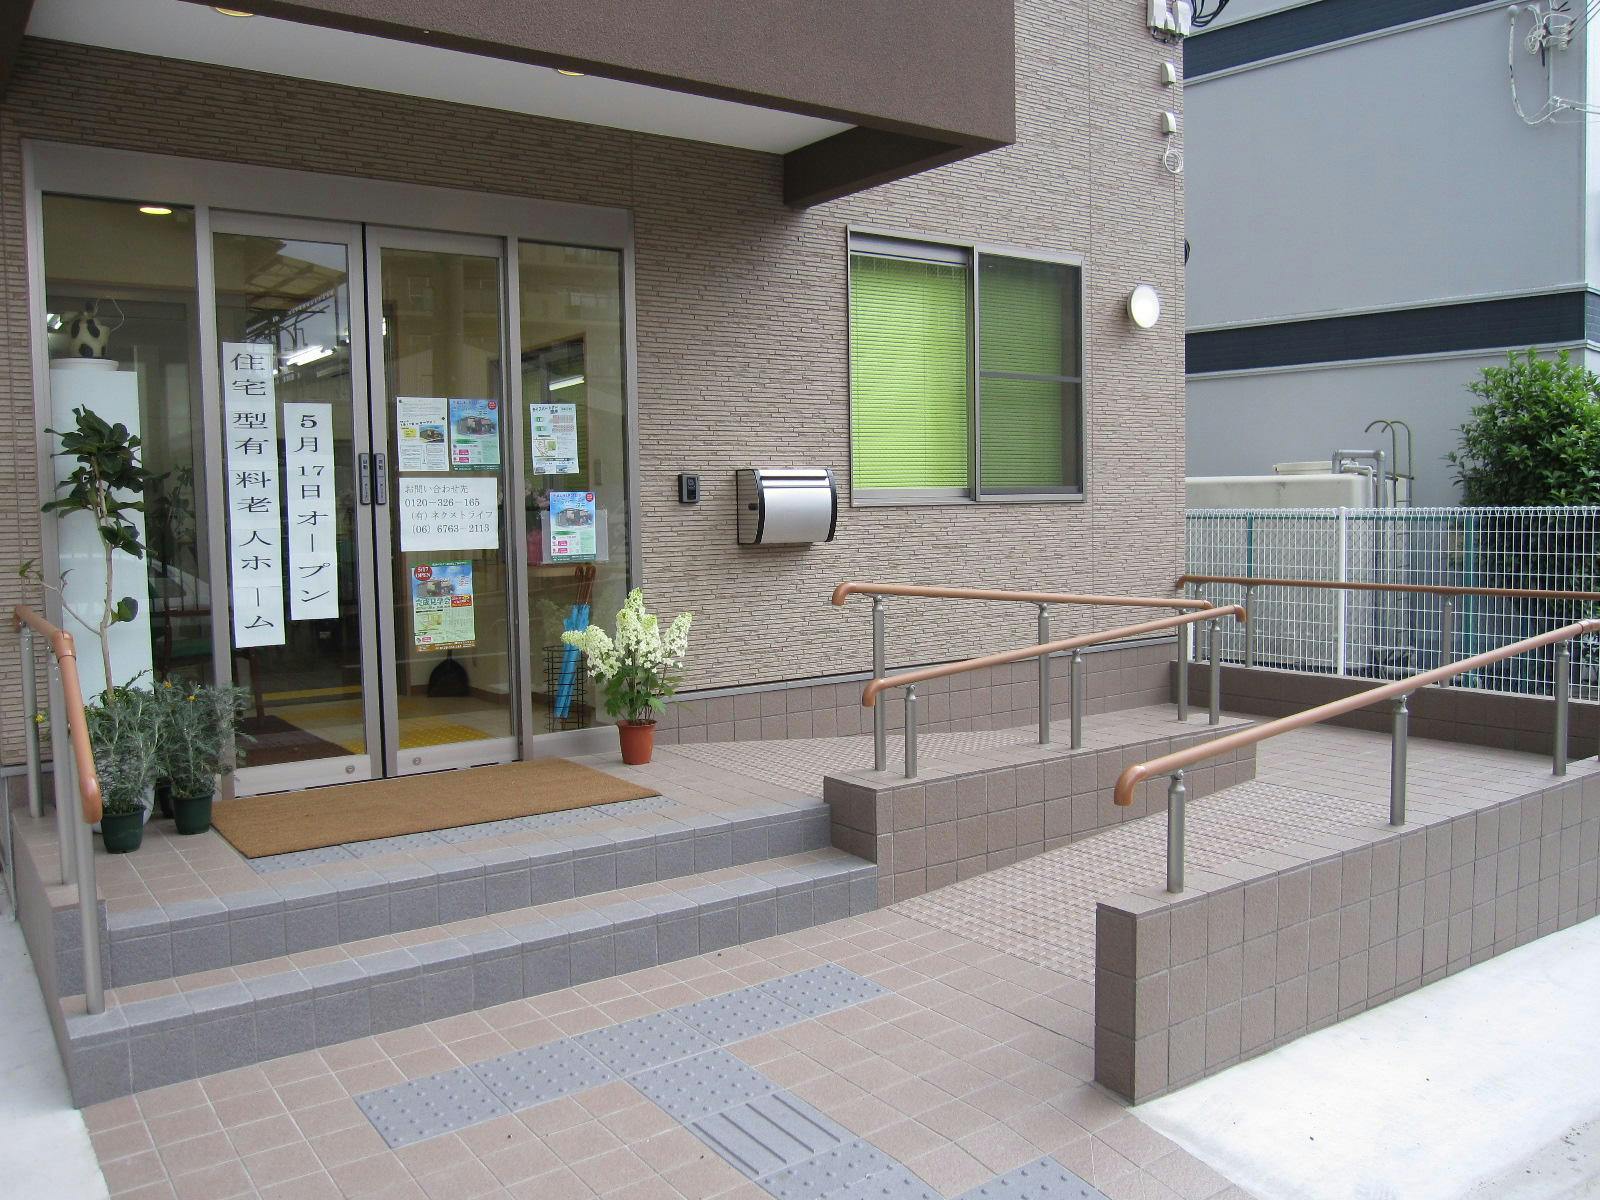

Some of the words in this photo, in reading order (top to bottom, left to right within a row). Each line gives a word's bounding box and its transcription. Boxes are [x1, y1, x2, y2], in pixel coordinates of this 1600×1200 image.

[230, 353, 274, 630] 住宅型有料老人ホーム
[294, 414, 331, 603] 5月17日オープン
[404, 484, 469, 494] お問い合わせ先
